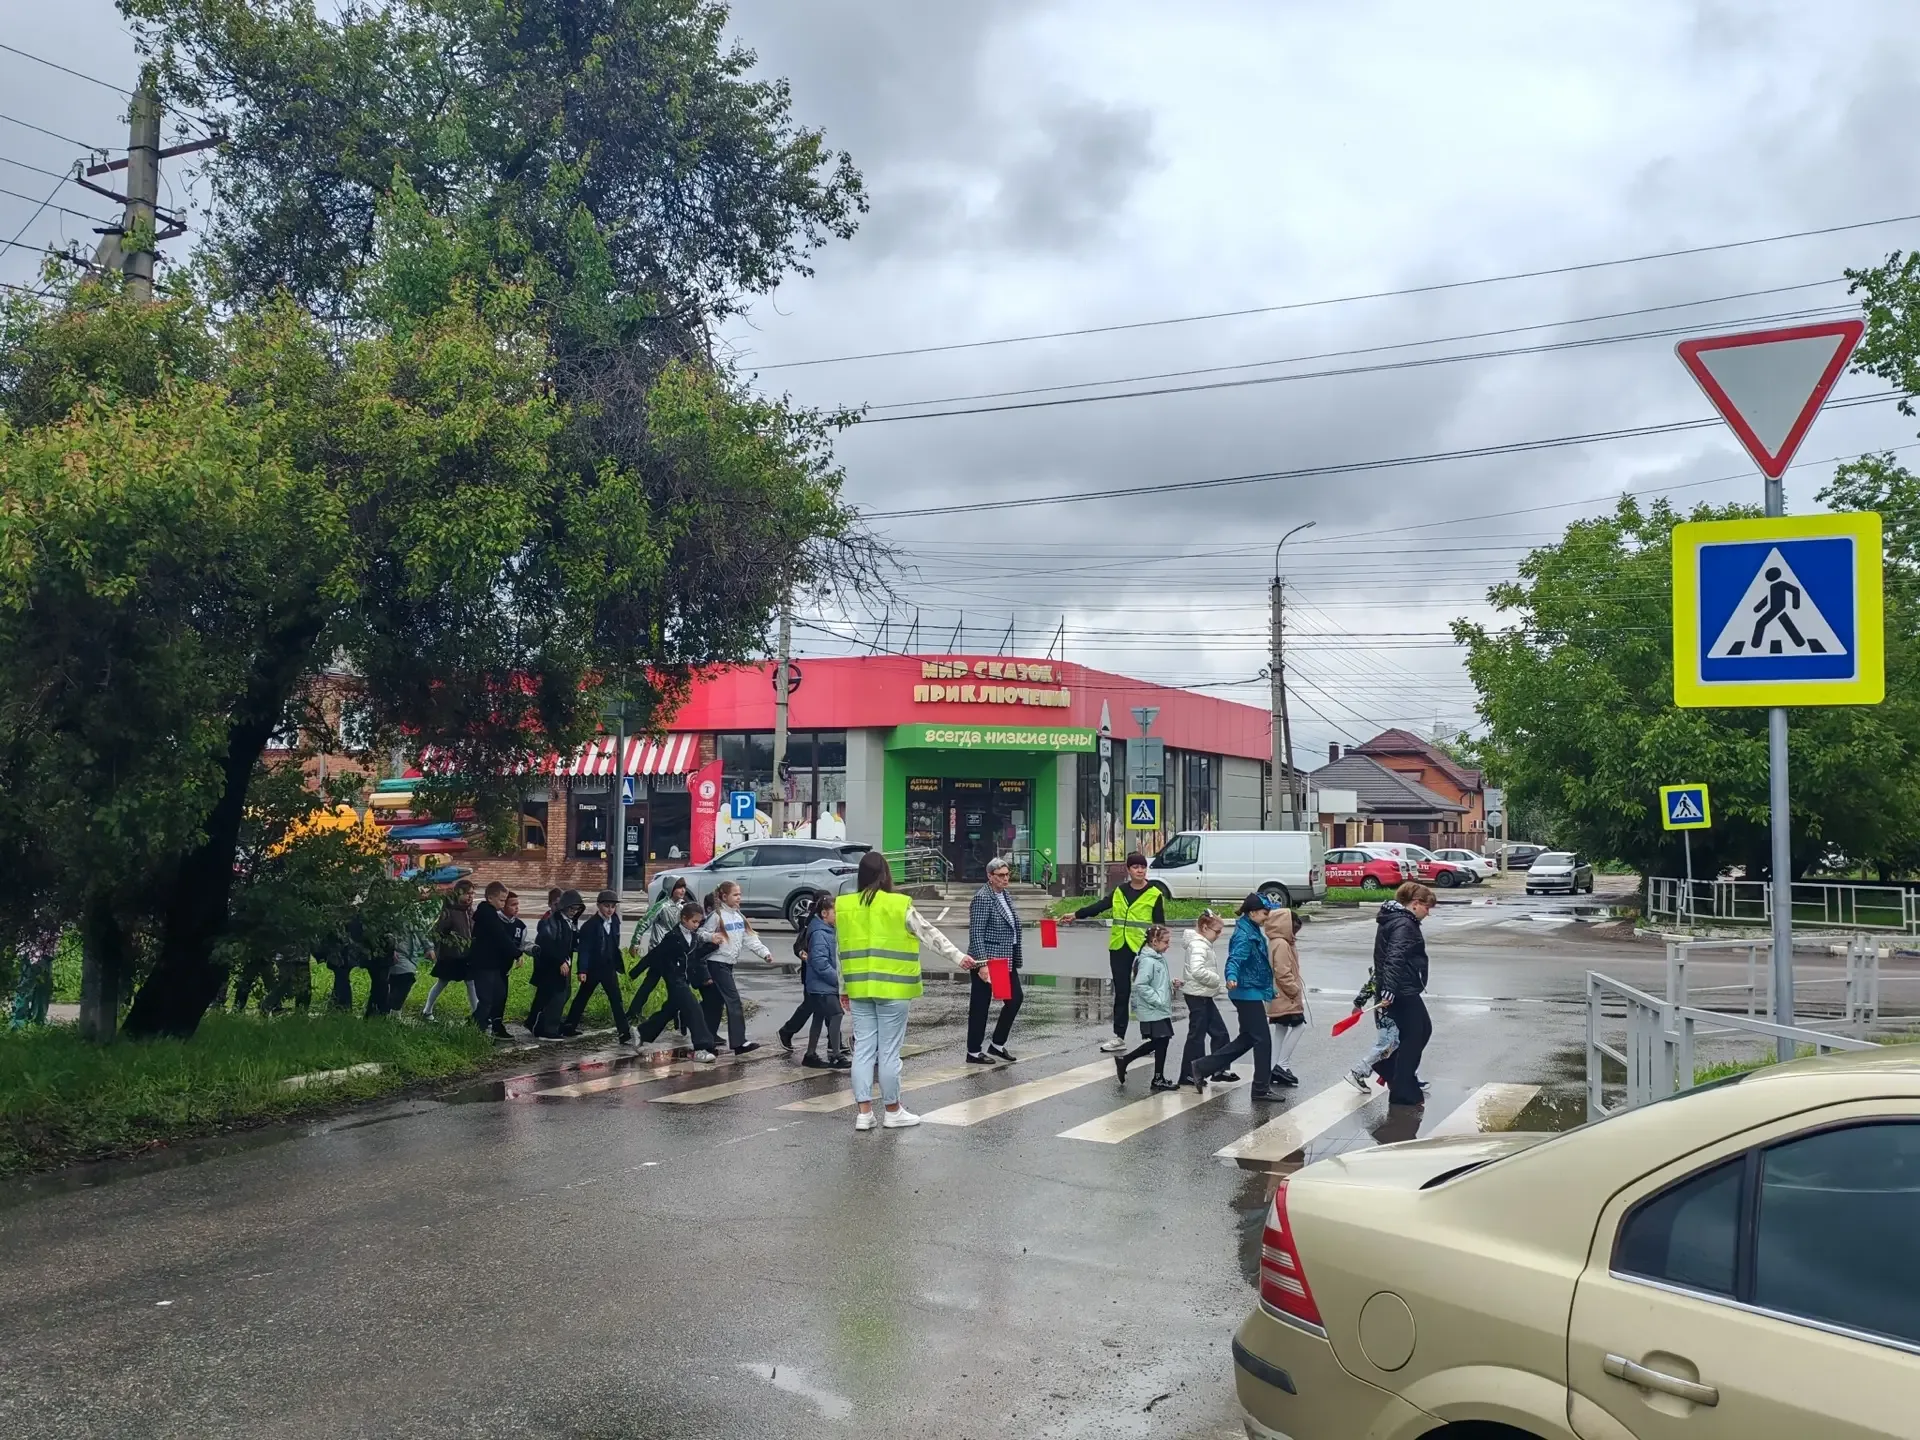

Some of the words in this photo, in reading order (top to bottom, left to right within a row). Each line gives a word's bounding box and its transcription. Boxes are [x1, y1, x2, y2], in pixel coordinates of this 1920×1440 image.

[922, 661, 968, 679] МИР
[973, 661, 1053, 682] СКАЗОК
[913, 684, 1071, 707] ПРИКЛЮЧЕНИЙ
[984, 731, 1047, 745] низкие
[1049, 732, 1092, 749] цены
[736, 795, 751, 817] P
[514, 927, 521, 938] R
